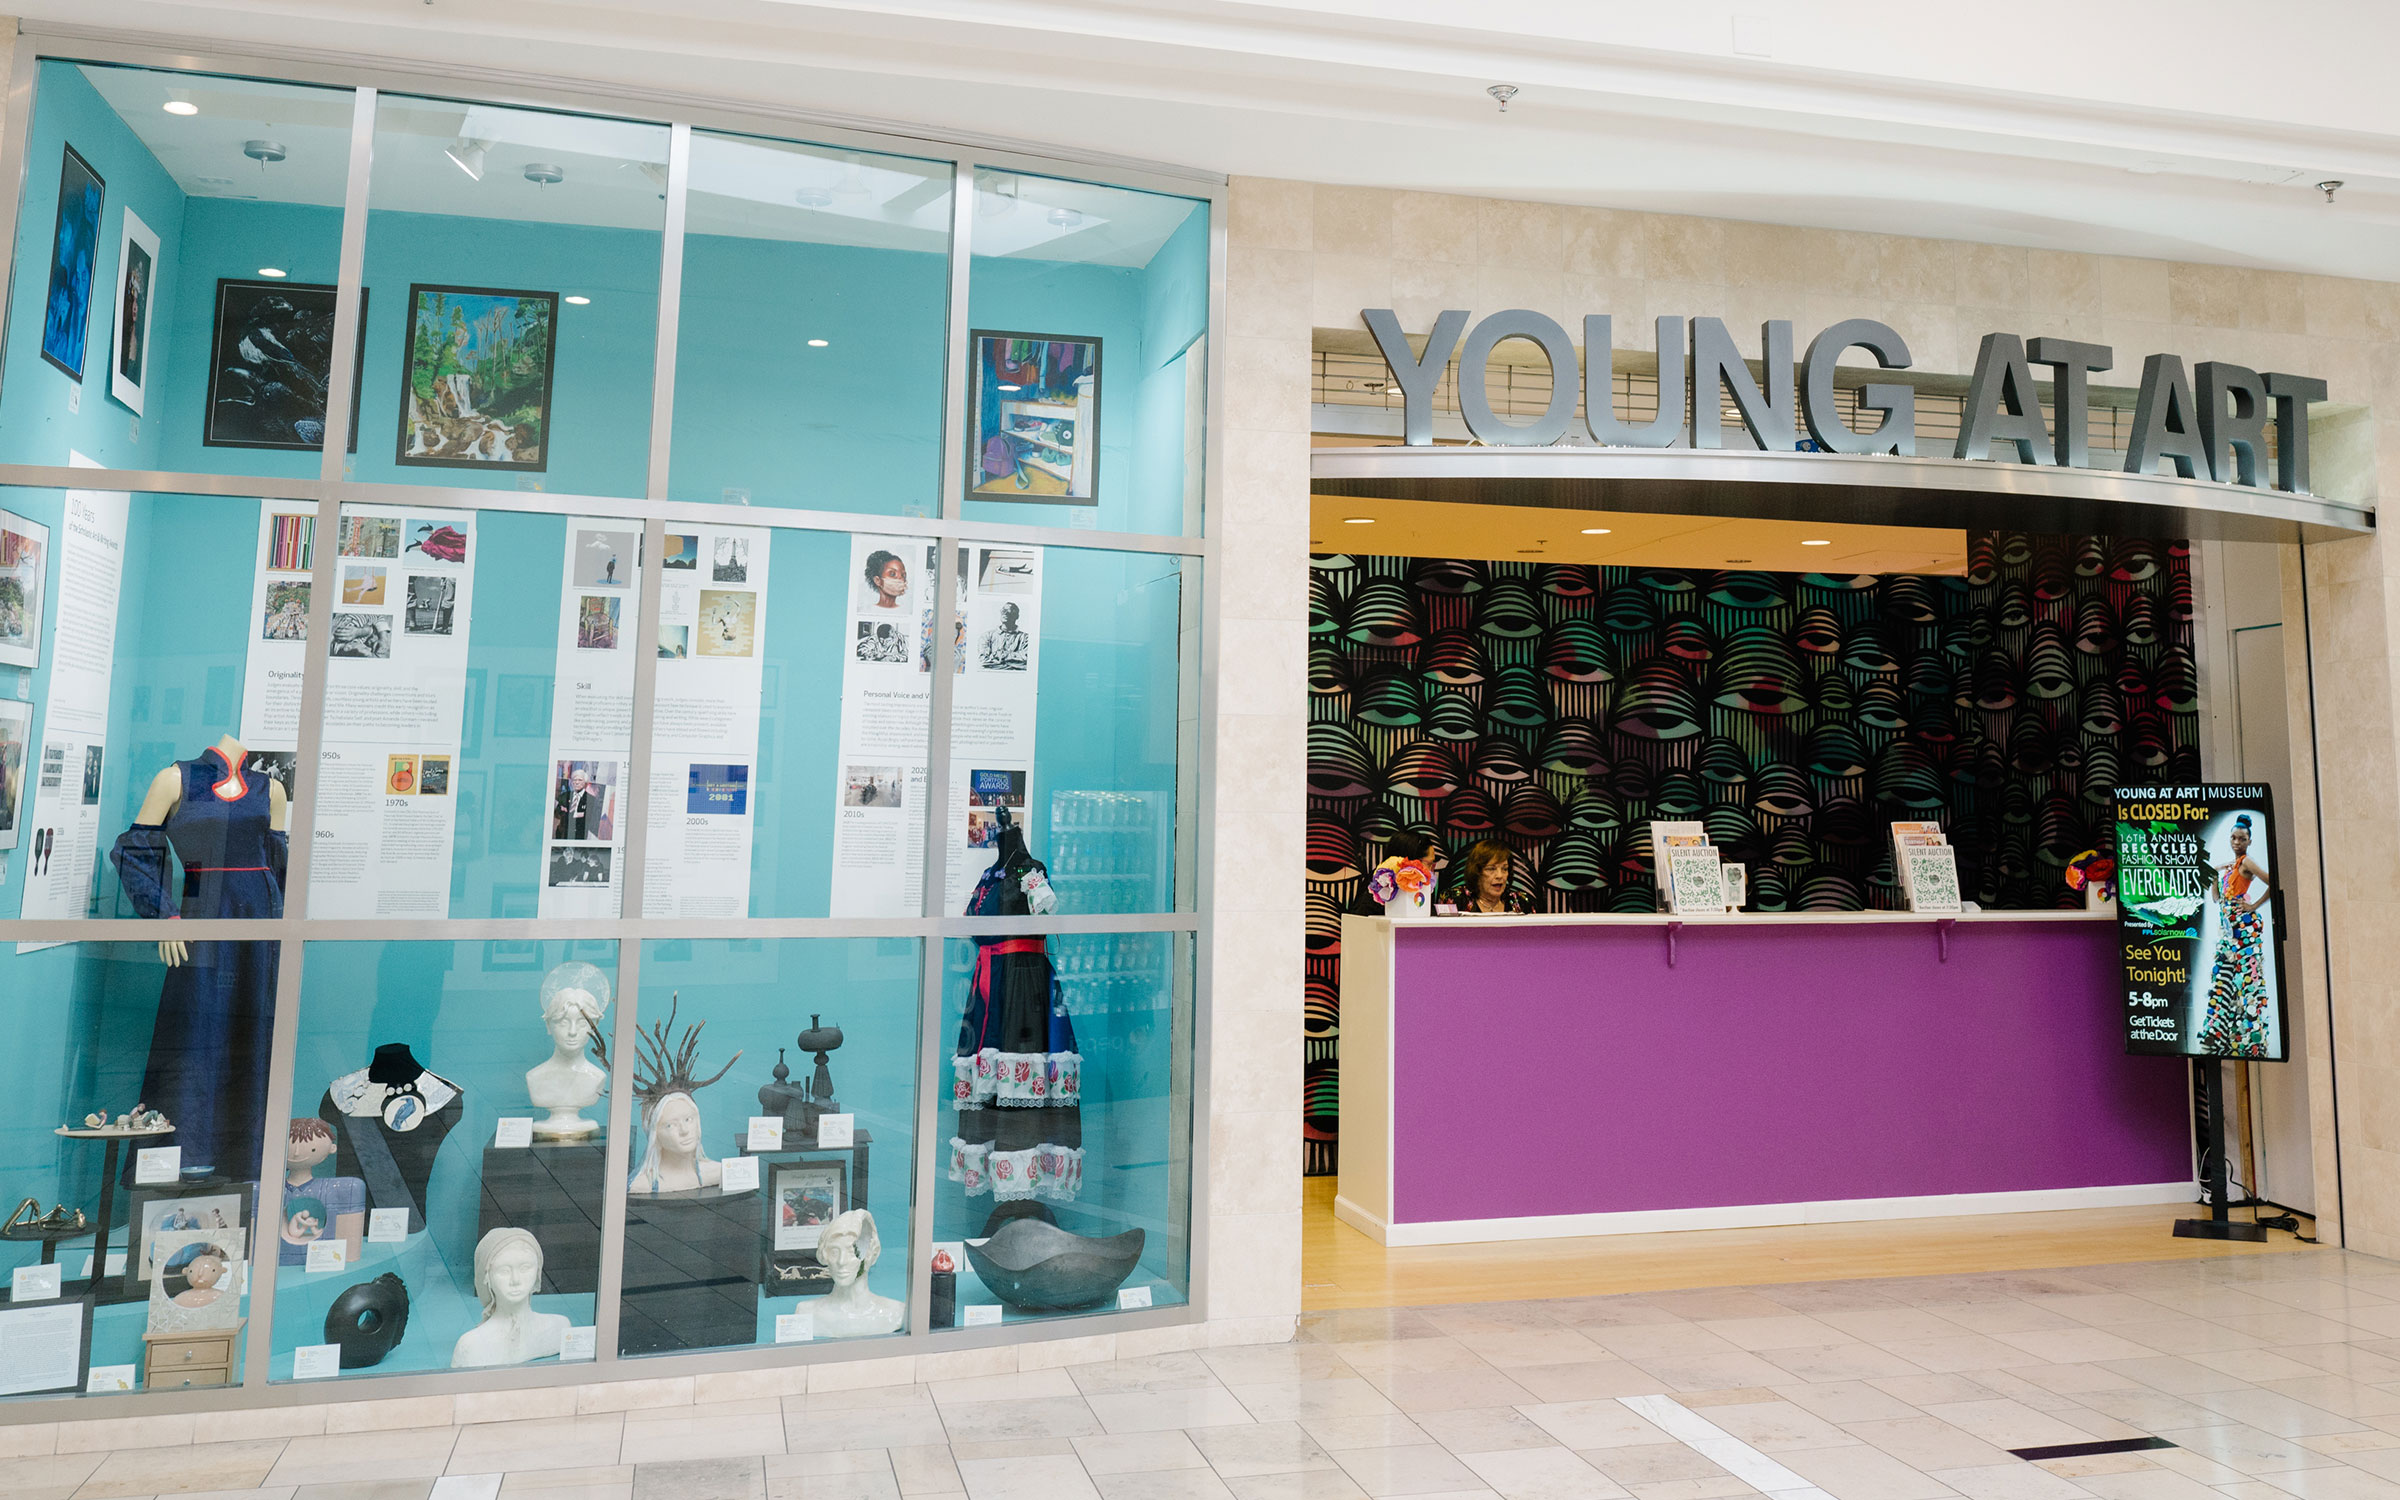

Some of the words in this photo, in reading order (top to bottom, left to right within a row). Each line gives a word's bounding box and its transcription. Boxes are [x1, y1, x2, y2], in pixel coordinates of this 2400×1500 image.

[1360, 308, 1916, 457] YOUNG
[1953, 332, 2113, 468] AT
[2123, 353, 2328, 497] ART
[576, 682, 592, 690] Skill
[863, 690, 892, 698] Personal
[893, 691, 910, 699] Voice
[911, 692, 924, 700] and
[322, 751, 341, 760] 950s
[979, 782, 1010, 790] AWARDS
[708, 793, 734, 801] 2001
[2114, 787, 2157, 799] YOUNG
[2159, 787, 2173, 799] AT
[2175, 787, 2200, 799] ART
[2208, 786, 2263, 799] MUSEUM
[385, 799, 409, 807] 1970s
[843, 810, 865, 818] 2010s
[2117, 804, 2128, 820] Is
[2130, 803, 2182, 821] CLOSED
[2183, 804, 2210, 821] For:
[686, 817, 709, 825] 2000s
[315, 830, 335, 839] 960s
[2120, 833, 2147, 843] 16TH
[2150, 833, 2197, 843] ANNUAL
[1671, 848, 1691, 857] SILENT
[1692, 848, 1717, 857] AUCTION
[1908, 848, 1927, 856] SILENT
[1928, 848, 1952, 856] AUCTION
[2121, 843, 2198, 854] RECYCLED
[2122, 854, 2163, 865] FASHION
[2164, 854, 2198, 865] SHOW
[2122, 868, 2202, 897] EVERGLADES
[2125, 944, 2152, 960] See
[2153, 945, 2181, 961] You
[2126, 966, 2186, 987] Tonight!
[2128, 991, 2169, 1009] 5-8pm
[2129, 1015, 2145, 1027] Get
[2145, 1015, 2175, 1028] Tickets
[2130, 1030, 2139, 1040] at
[2139, 1029, 2155, 1040] the
[2155, 1029, 2179, 1041] Door
